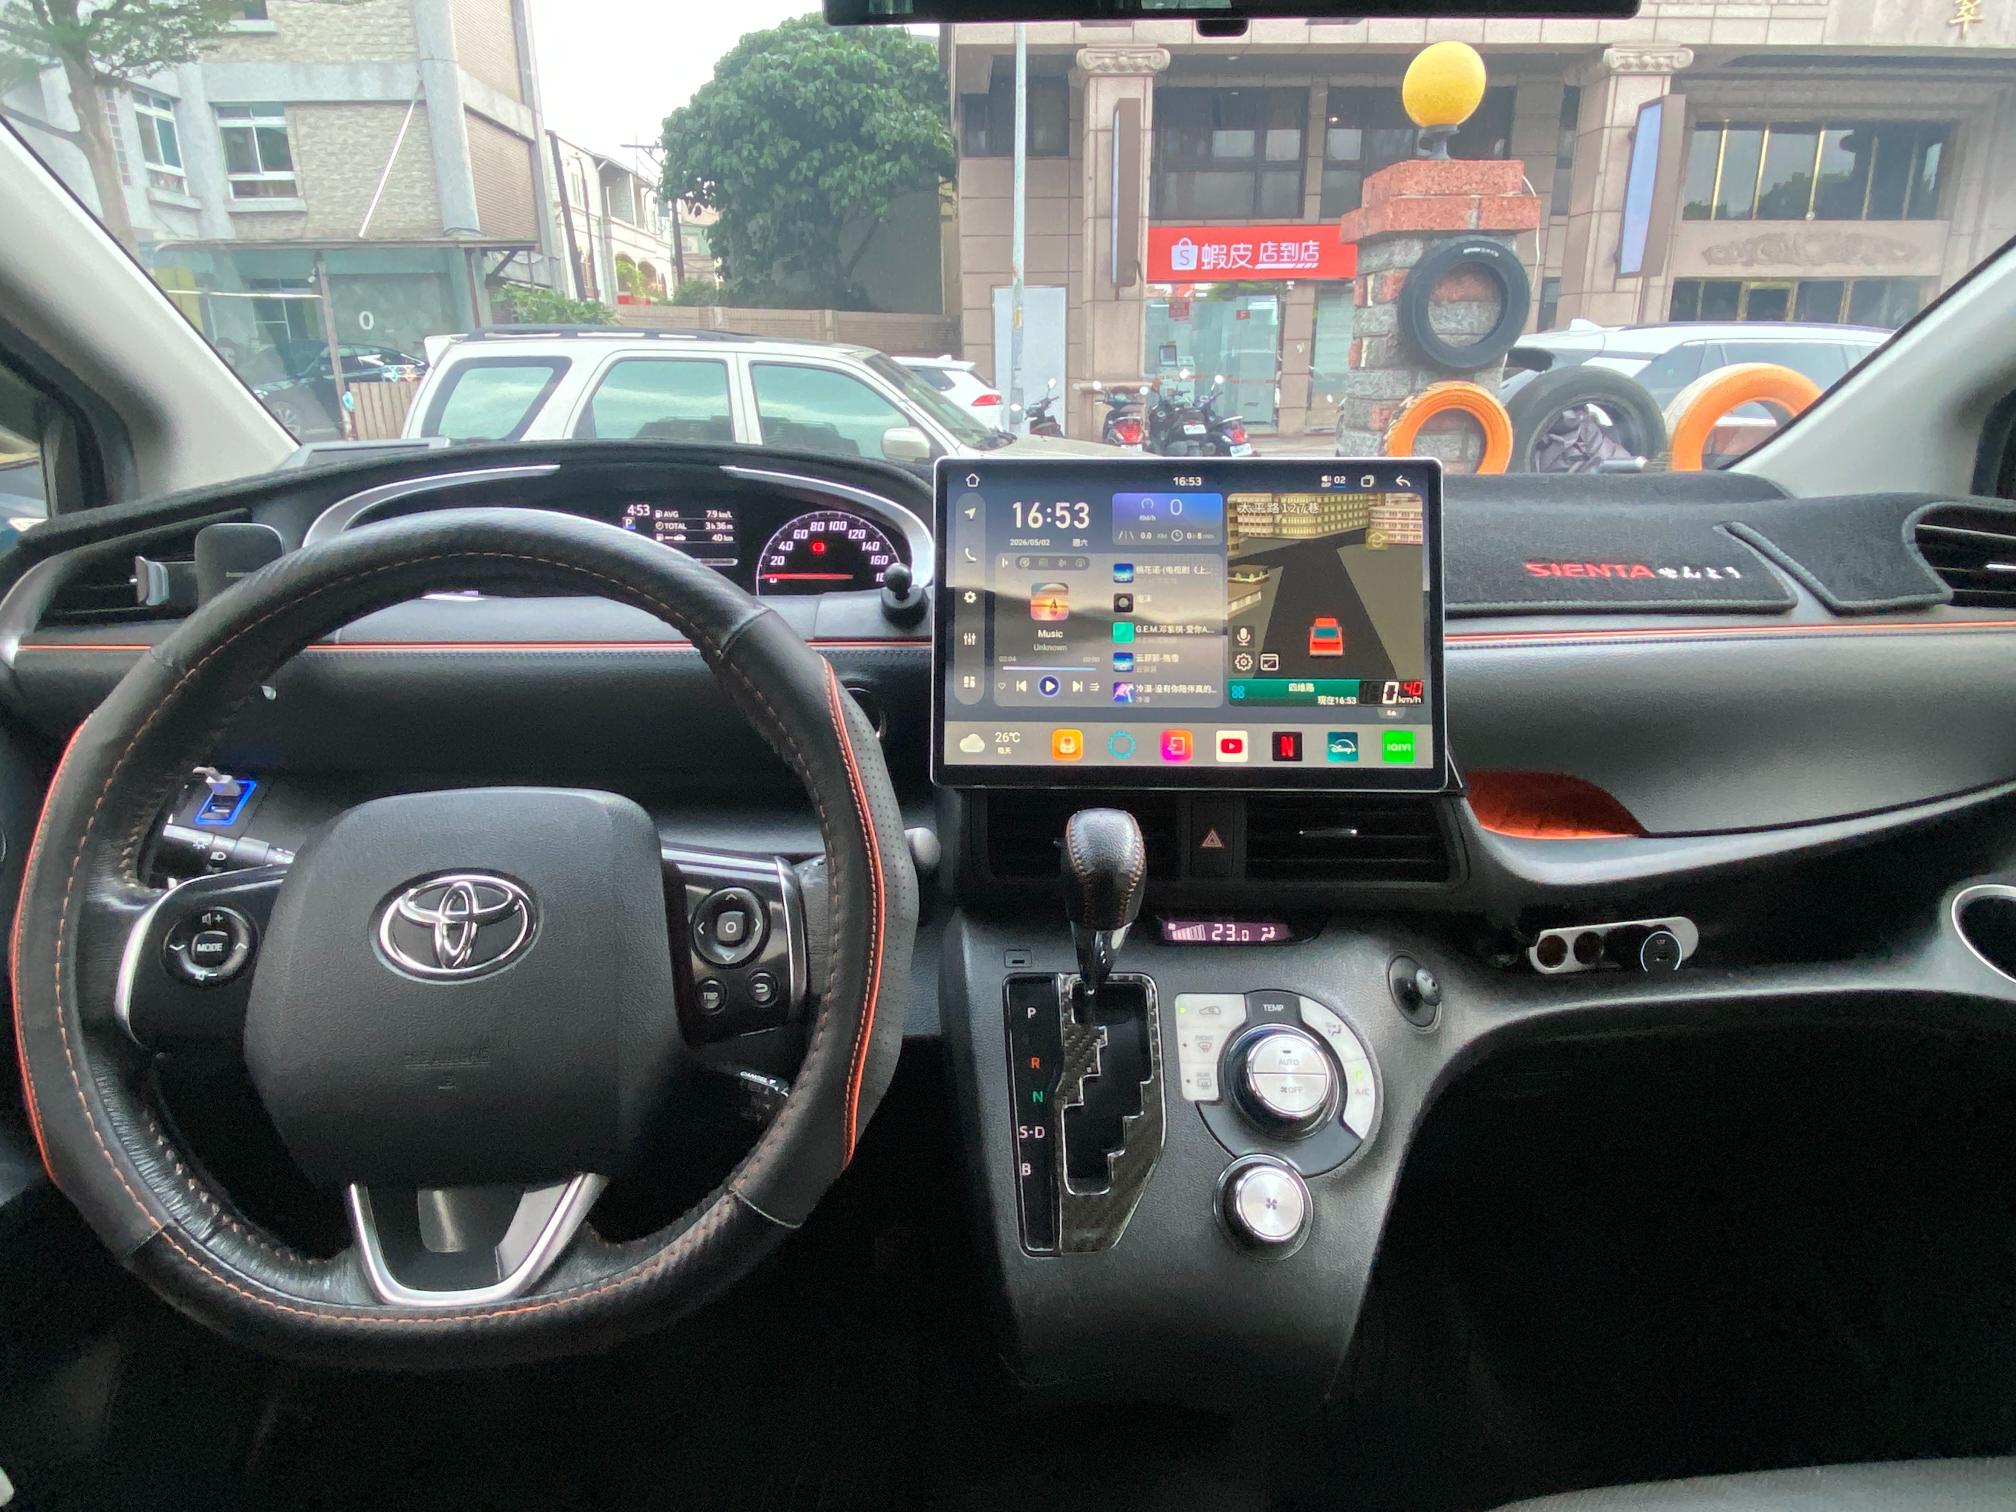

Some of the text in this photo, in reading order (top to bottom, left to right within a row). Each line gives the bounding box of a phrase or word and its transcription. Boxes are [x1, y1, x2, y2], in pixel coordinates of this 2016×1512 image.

[1201, 243, 1253, 269] 蝦皮
[1259, 240, 1320, 262] 店到店
[1173, 476, 1202, 487] 16:53
[1333, 475, 1346, 484] 02
[627, 504, 650, 516] 4:53
[1170, 498, 1182, 516] 0
[1012, 501, 1090, 529] 16:53
[625, 518, 633, 528] P
[664, 522, 687, 530] TOTAL
[810, 521, 825, 532] 80
[829, 521, 847, 531] 100
[711, 534, 723, 542] 40
[793, 530, 809, 540] 60
[848, 530, 866, 539] 120
[778, 541, 794, 551] 40
[861, 541, 880, 551] 140
[1009, 538, 1050, 547] 2026/05/02
[770, 555, 785, 565] 20
[870, 555, 889, 565] 160
[1524, 561, 1656, 578] SIENTA
[1038, 629, 1063, 638] Music
[1382, 681, 1400, 704] 0
[1403, 682, 1423, 695] 40
[1398, 696, 1422, 704] km/h
[1212, 923, 1250, 941] 23.0
[197, 943, 223, 952] MODE
[703, 991, 719, 1000] TRIP
[1027, 1007, 1037, 1019] P
[1031, 1057, 1040, 1069] R
[1032, 1091, 1043, 1103] N
[1021, 1163, 1032, 1176] B
